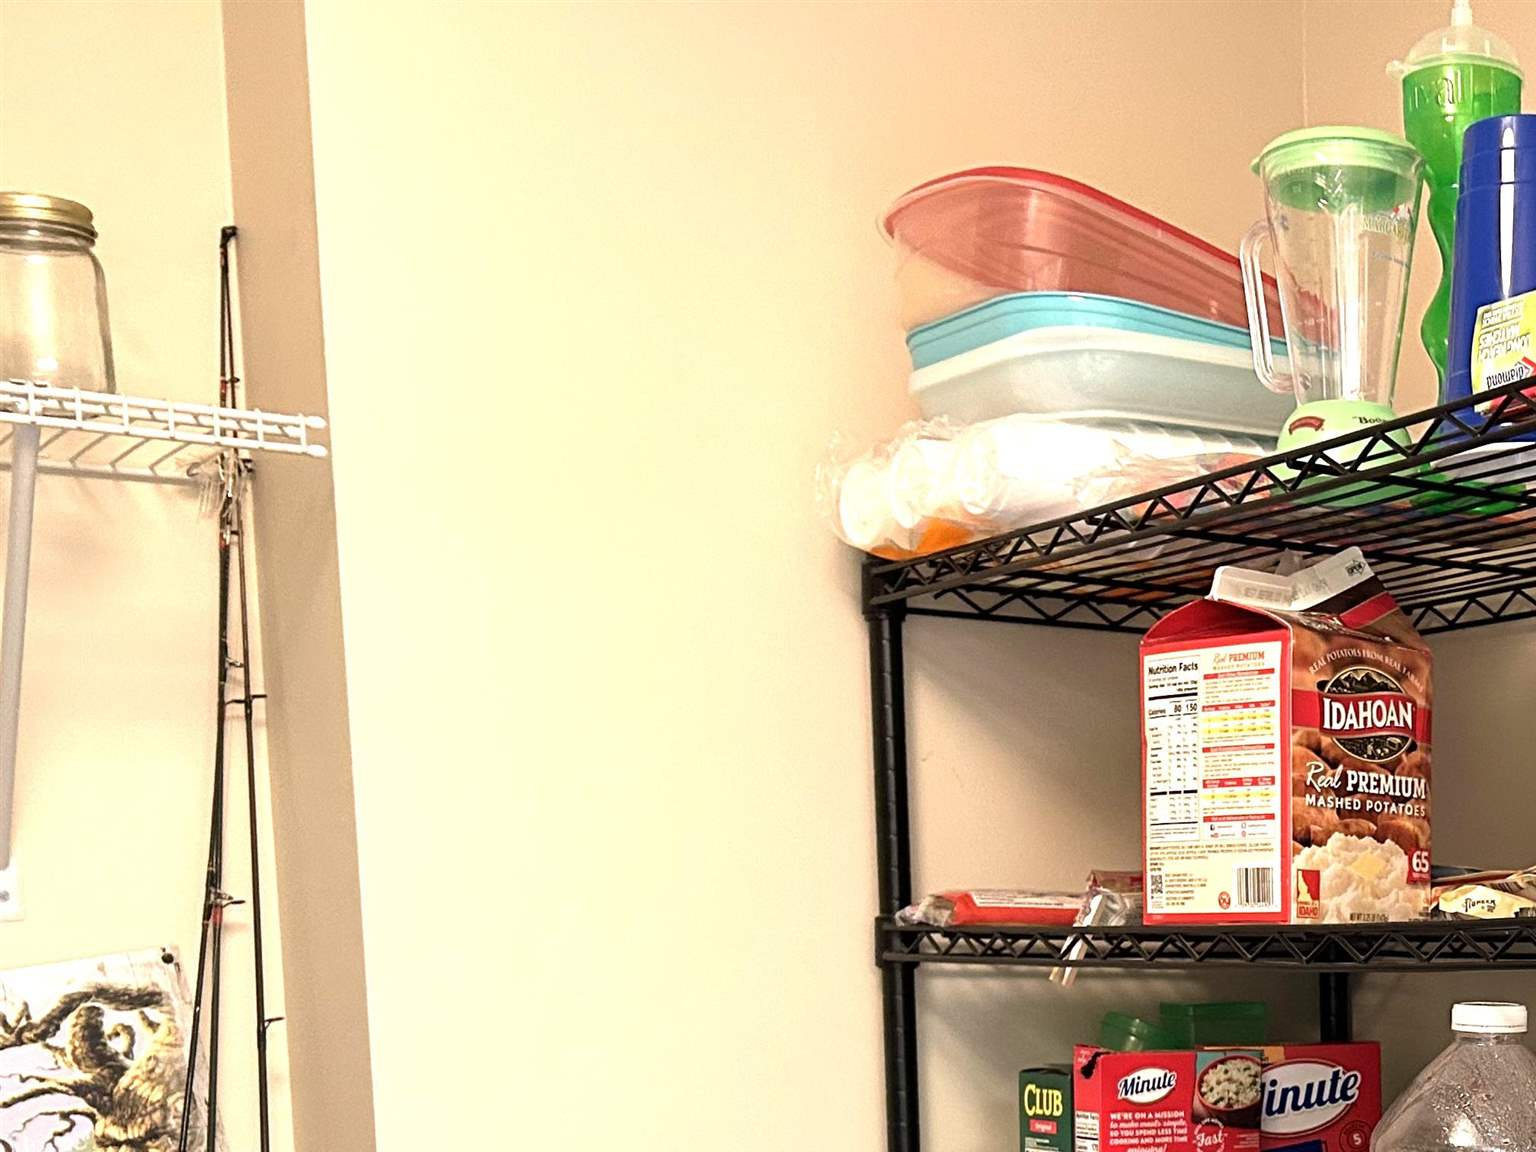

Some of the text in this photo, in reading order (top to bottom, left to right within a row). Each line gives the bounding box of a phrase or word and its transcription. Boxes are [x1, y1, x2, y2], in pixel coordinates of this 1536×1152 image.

[1148, 662, 1199, 675] Nutrition Facts
[1174, 704, 1182, 713] 80
[1186, 703, 1197, 712] 150
[1322, 698, 1413, 730] IDAHOAN
[1305, 761, 1426, 799] Real PREMIUM
[1304, 793, 1426, 817] MASHED POTATOES
[1412, 850, 1429, 873] 65
[1299, 905, 1318, 916] IDAHO
[1118, 1071, 1177, 1098] Minute
[1261, 1068, 1361, 1117] inute
[1024, 1084, 1063, 1117] CLUB
[1147, 1111, 1153, 1119] A
[1154, 1110, 1184, 1118] MISSION
[1157, 1128, 1172, 1136] LESS
[1196, 1130, 1224, 1146] Fast
[1110, 1137, 1139, 1145] COOKING
[1155, 1136, 1173, 1144] MORE
[1353, 1135, 1361, 1146] 5
